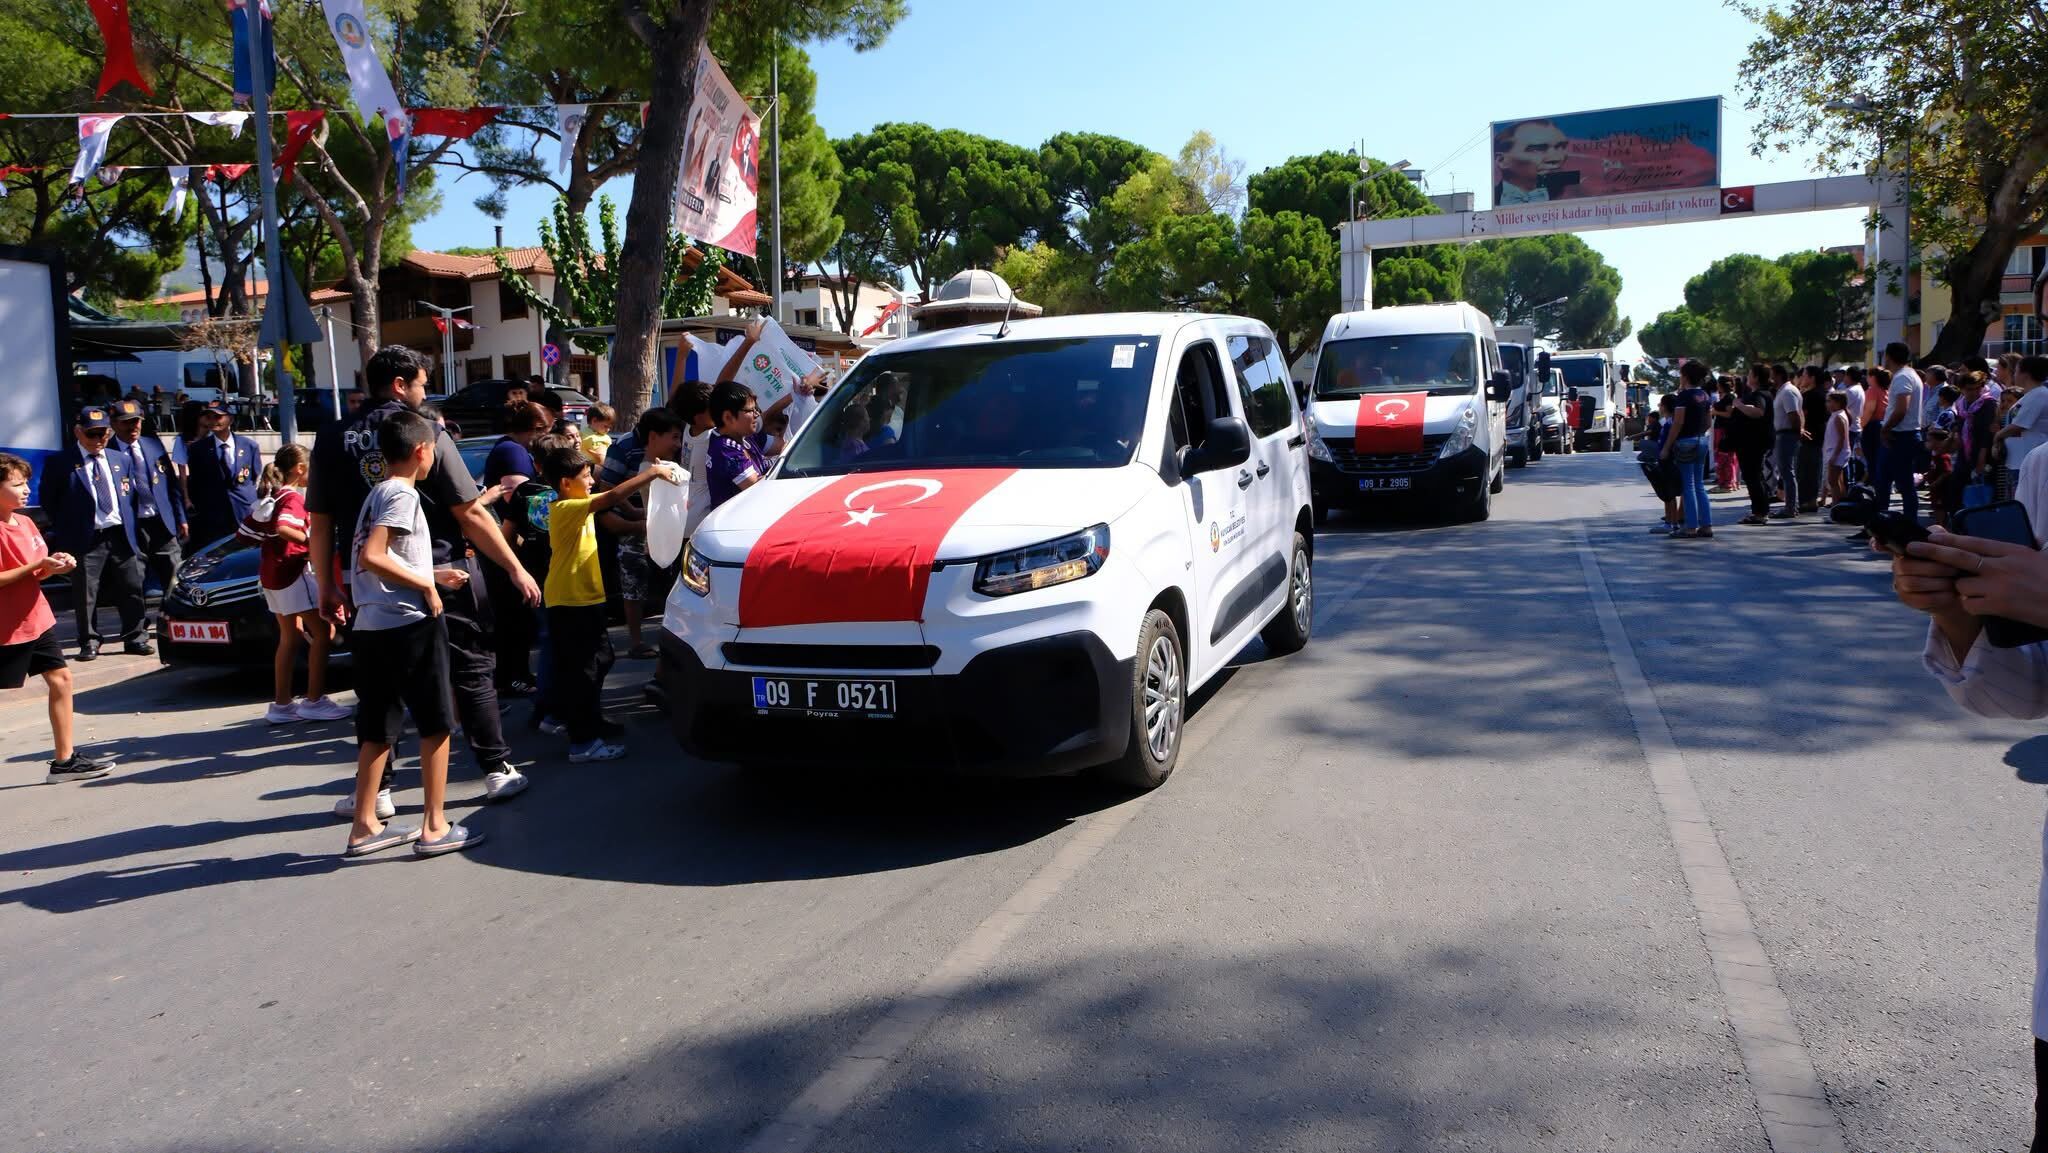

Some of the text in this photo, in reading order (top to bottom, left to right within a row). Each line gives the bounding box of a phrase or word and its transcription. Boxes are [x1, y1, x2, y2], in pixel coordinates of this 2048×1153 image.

[1495, 213, 1524, 225] Millet
[1526, 208, 1559, 224] sevgisi
[1562, 207, 1593, 220] kadar
[1595, 203, 1627, 217] büyük
[765, 373, 784, 393] ATIK
[344, 429, 381, 451] POL
[1379, 478, 1385, 488] F
[190, 625, 205, 639] AA
[756, 694, 766, 702] TR
[766, 681, 888, 709] 09 F 0521
[806, 710, 839, 718] Poyraz
